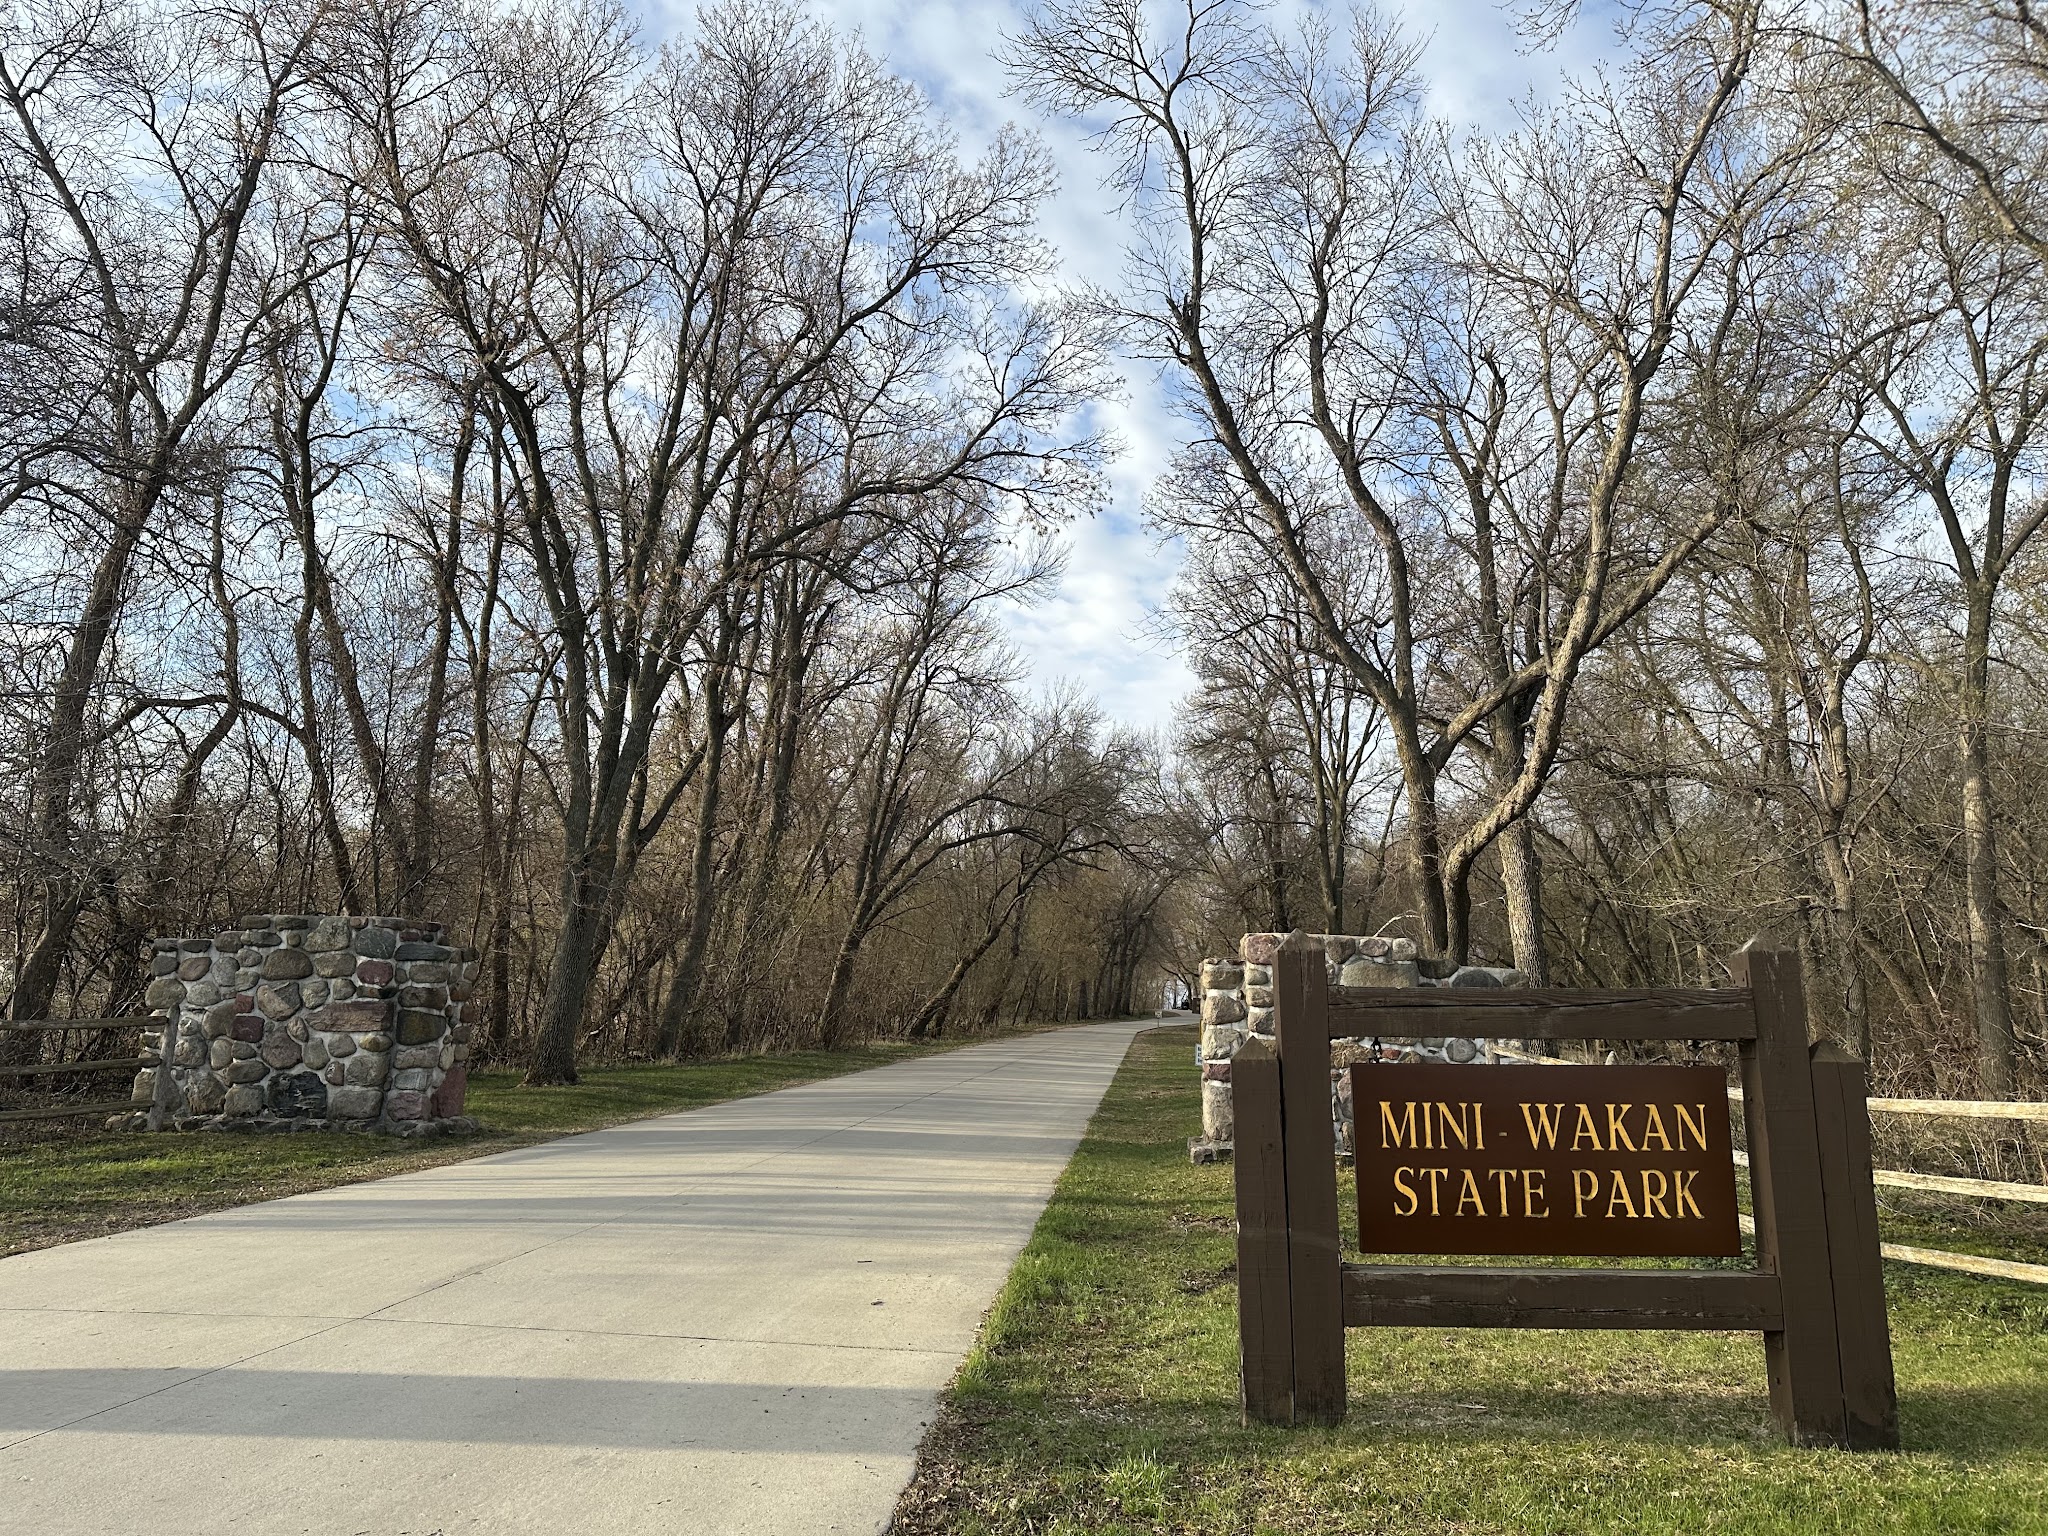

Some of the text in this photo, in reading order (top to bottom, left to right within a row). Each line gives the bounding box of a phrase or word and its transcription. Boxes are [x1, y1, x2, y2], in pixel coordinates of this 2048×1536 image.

[1379, 1101, 1485, 1150] MINI
[1518, 1103, 1707, 1152] WAKAN
[1393, 1166, 1705, 1220] STATE PARK
